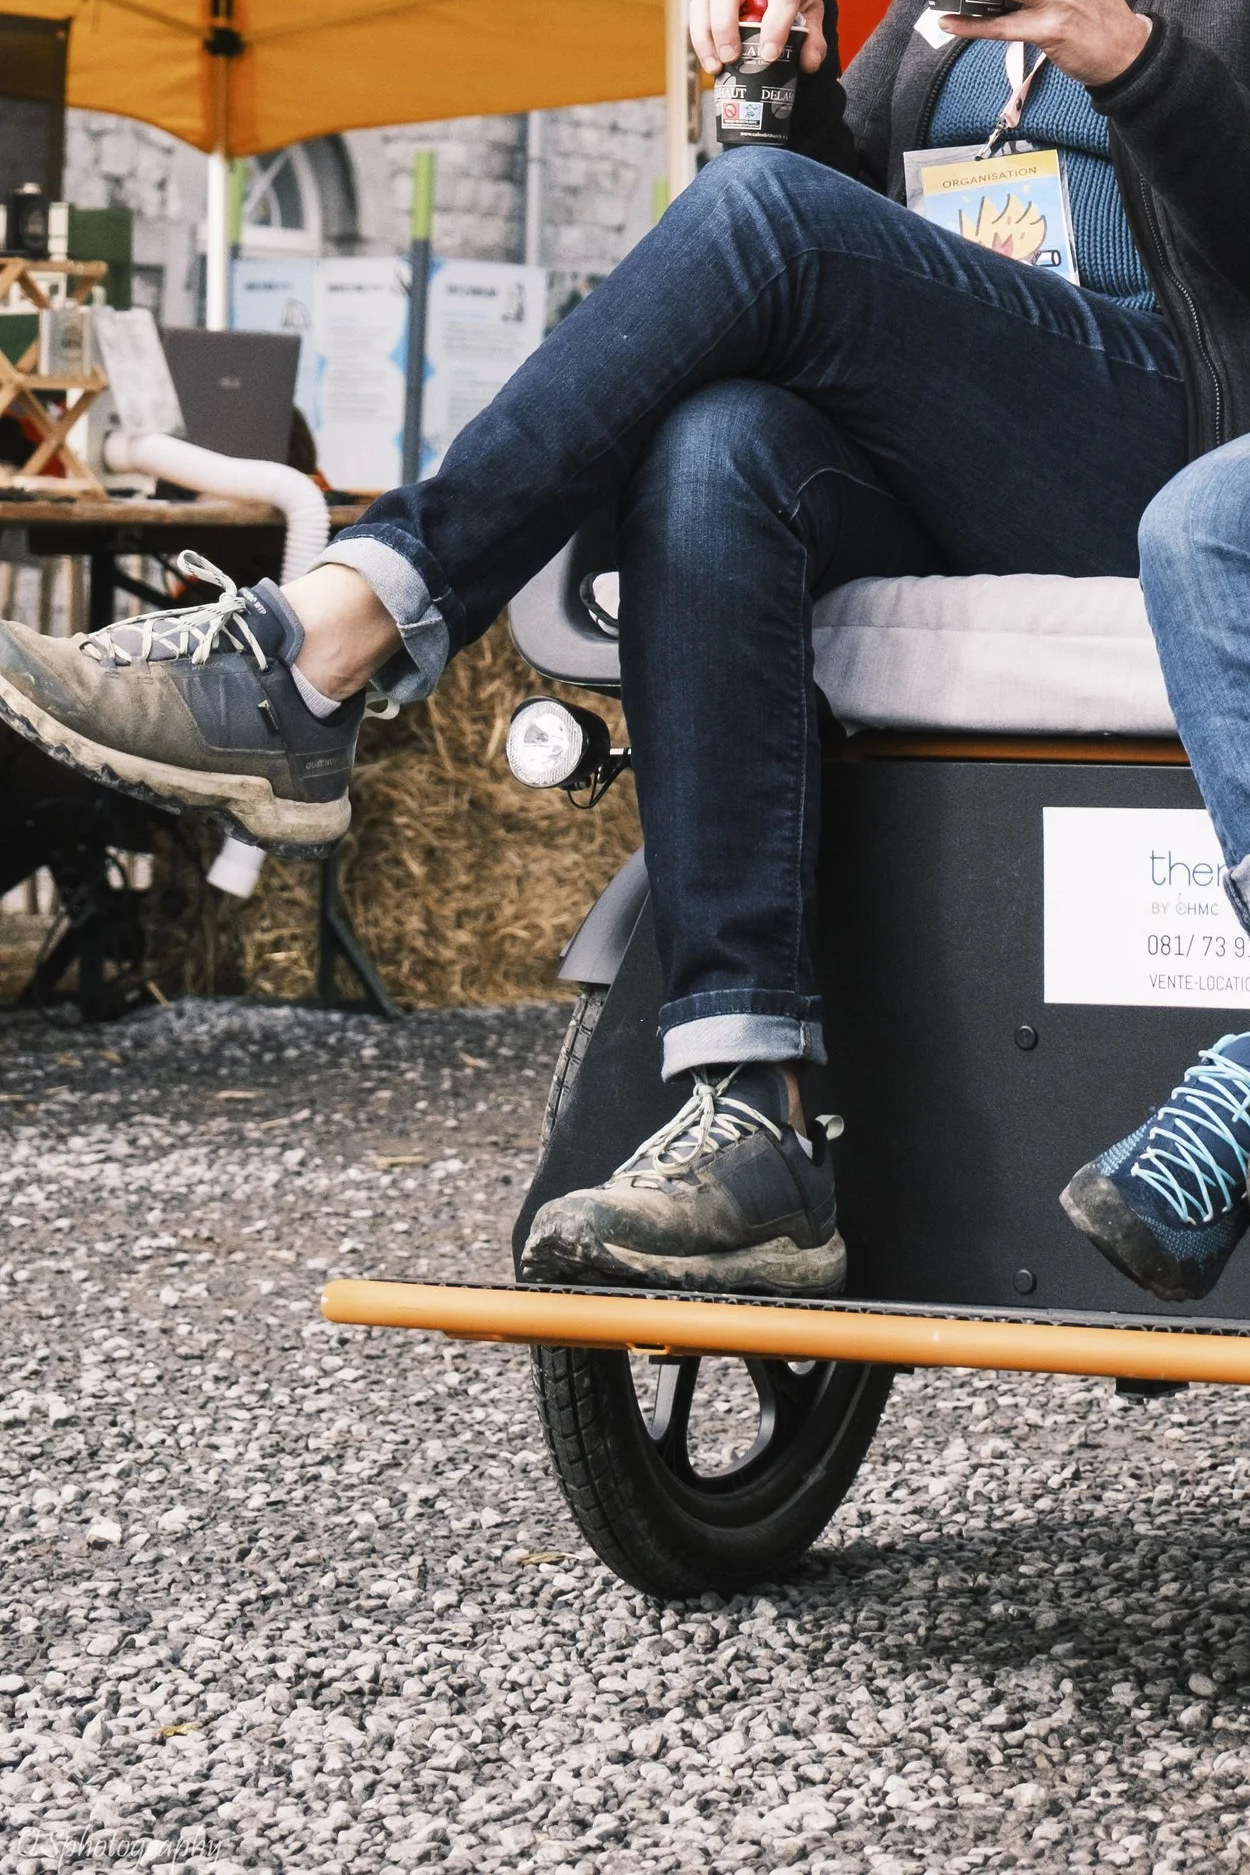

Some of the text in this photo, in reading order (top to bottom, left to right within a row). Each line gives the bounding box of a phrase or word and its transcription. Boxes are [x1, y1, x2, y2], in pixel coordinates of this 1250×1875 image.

[942, 166, 1037, 189] ORGANISATION
[1151, 902, 1169, 915] BY
[1147, 934, 1195, 958] 081/
[1202, 936, 1226, 958] 73
